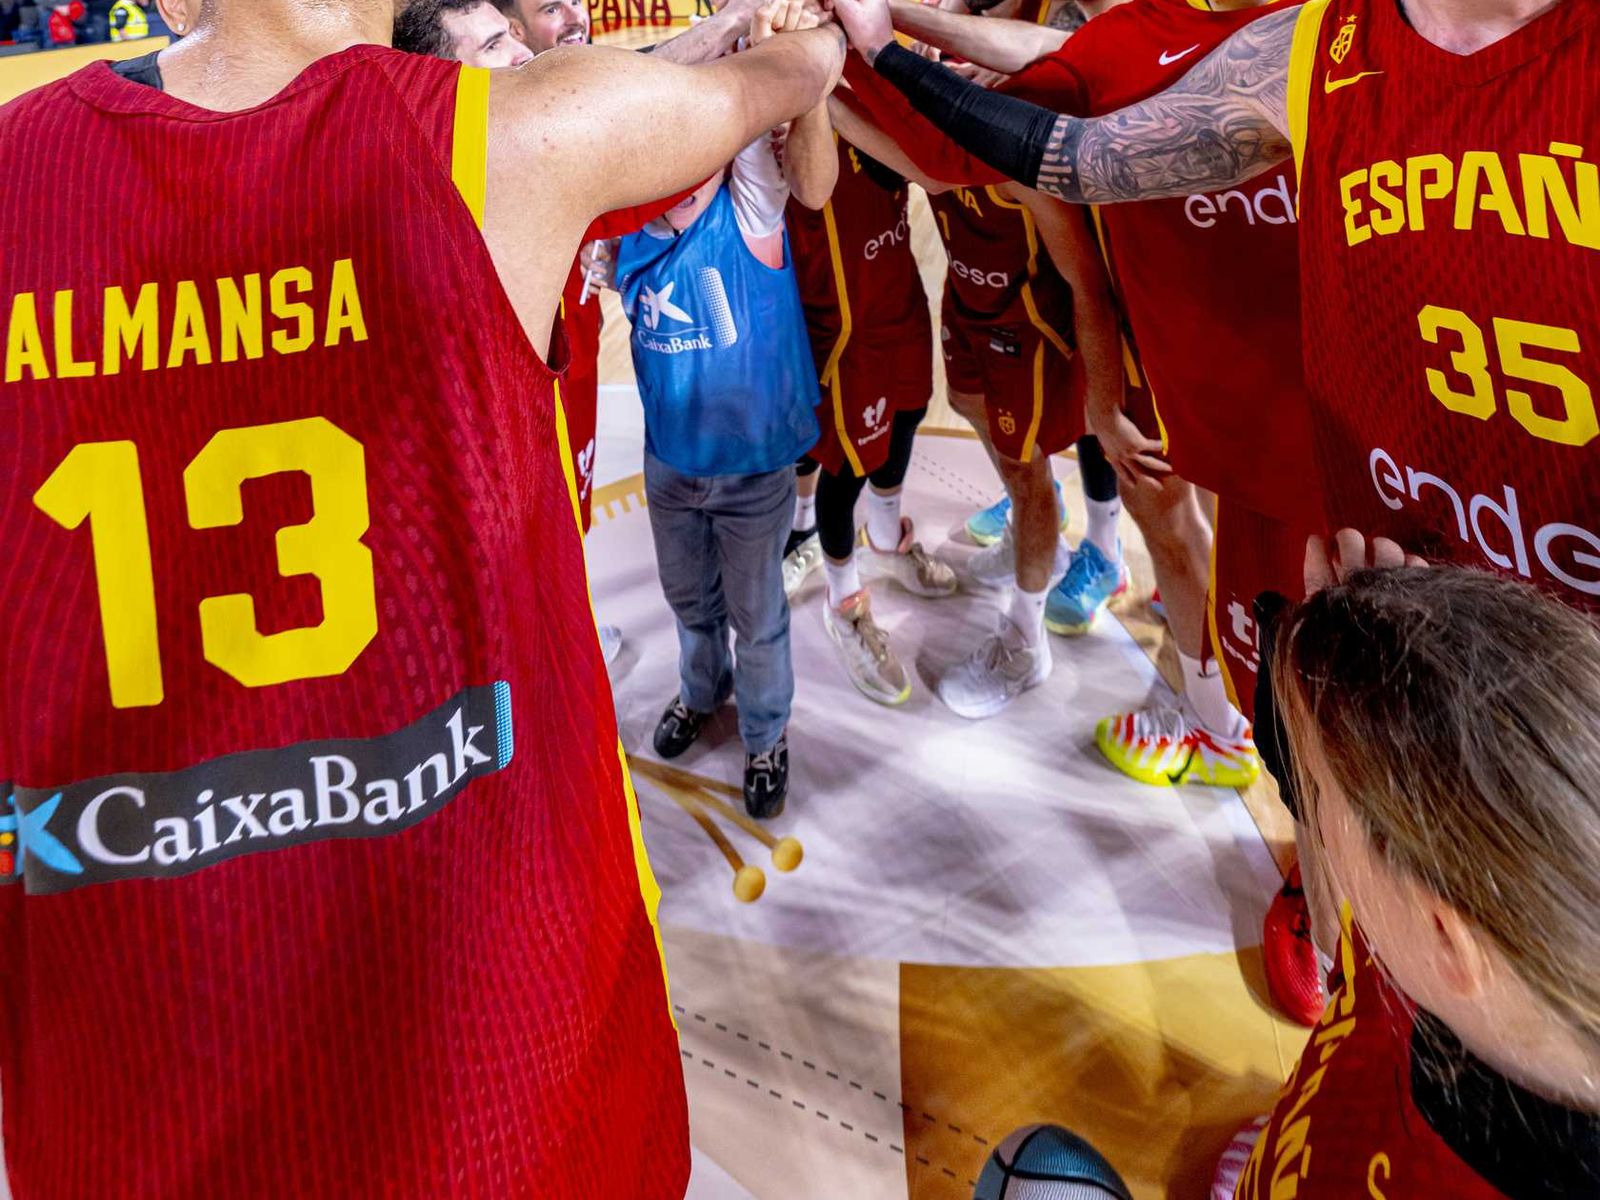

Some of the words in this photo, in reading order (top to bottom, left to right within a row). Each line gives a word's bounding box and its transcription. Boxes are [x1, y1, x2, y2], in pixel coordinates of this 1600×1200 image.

[1184, 174, 1299, 228] end
[5, 258, 369, 383] ALMANSA
[947, 249, 1009, 288] esa
[637, 329, 713, 354] CaixaBank
[1417, 304, 1600, 447] 35
[33, 416, 379, 709] 13
[76, 707, 492, 866] CaixaBank
